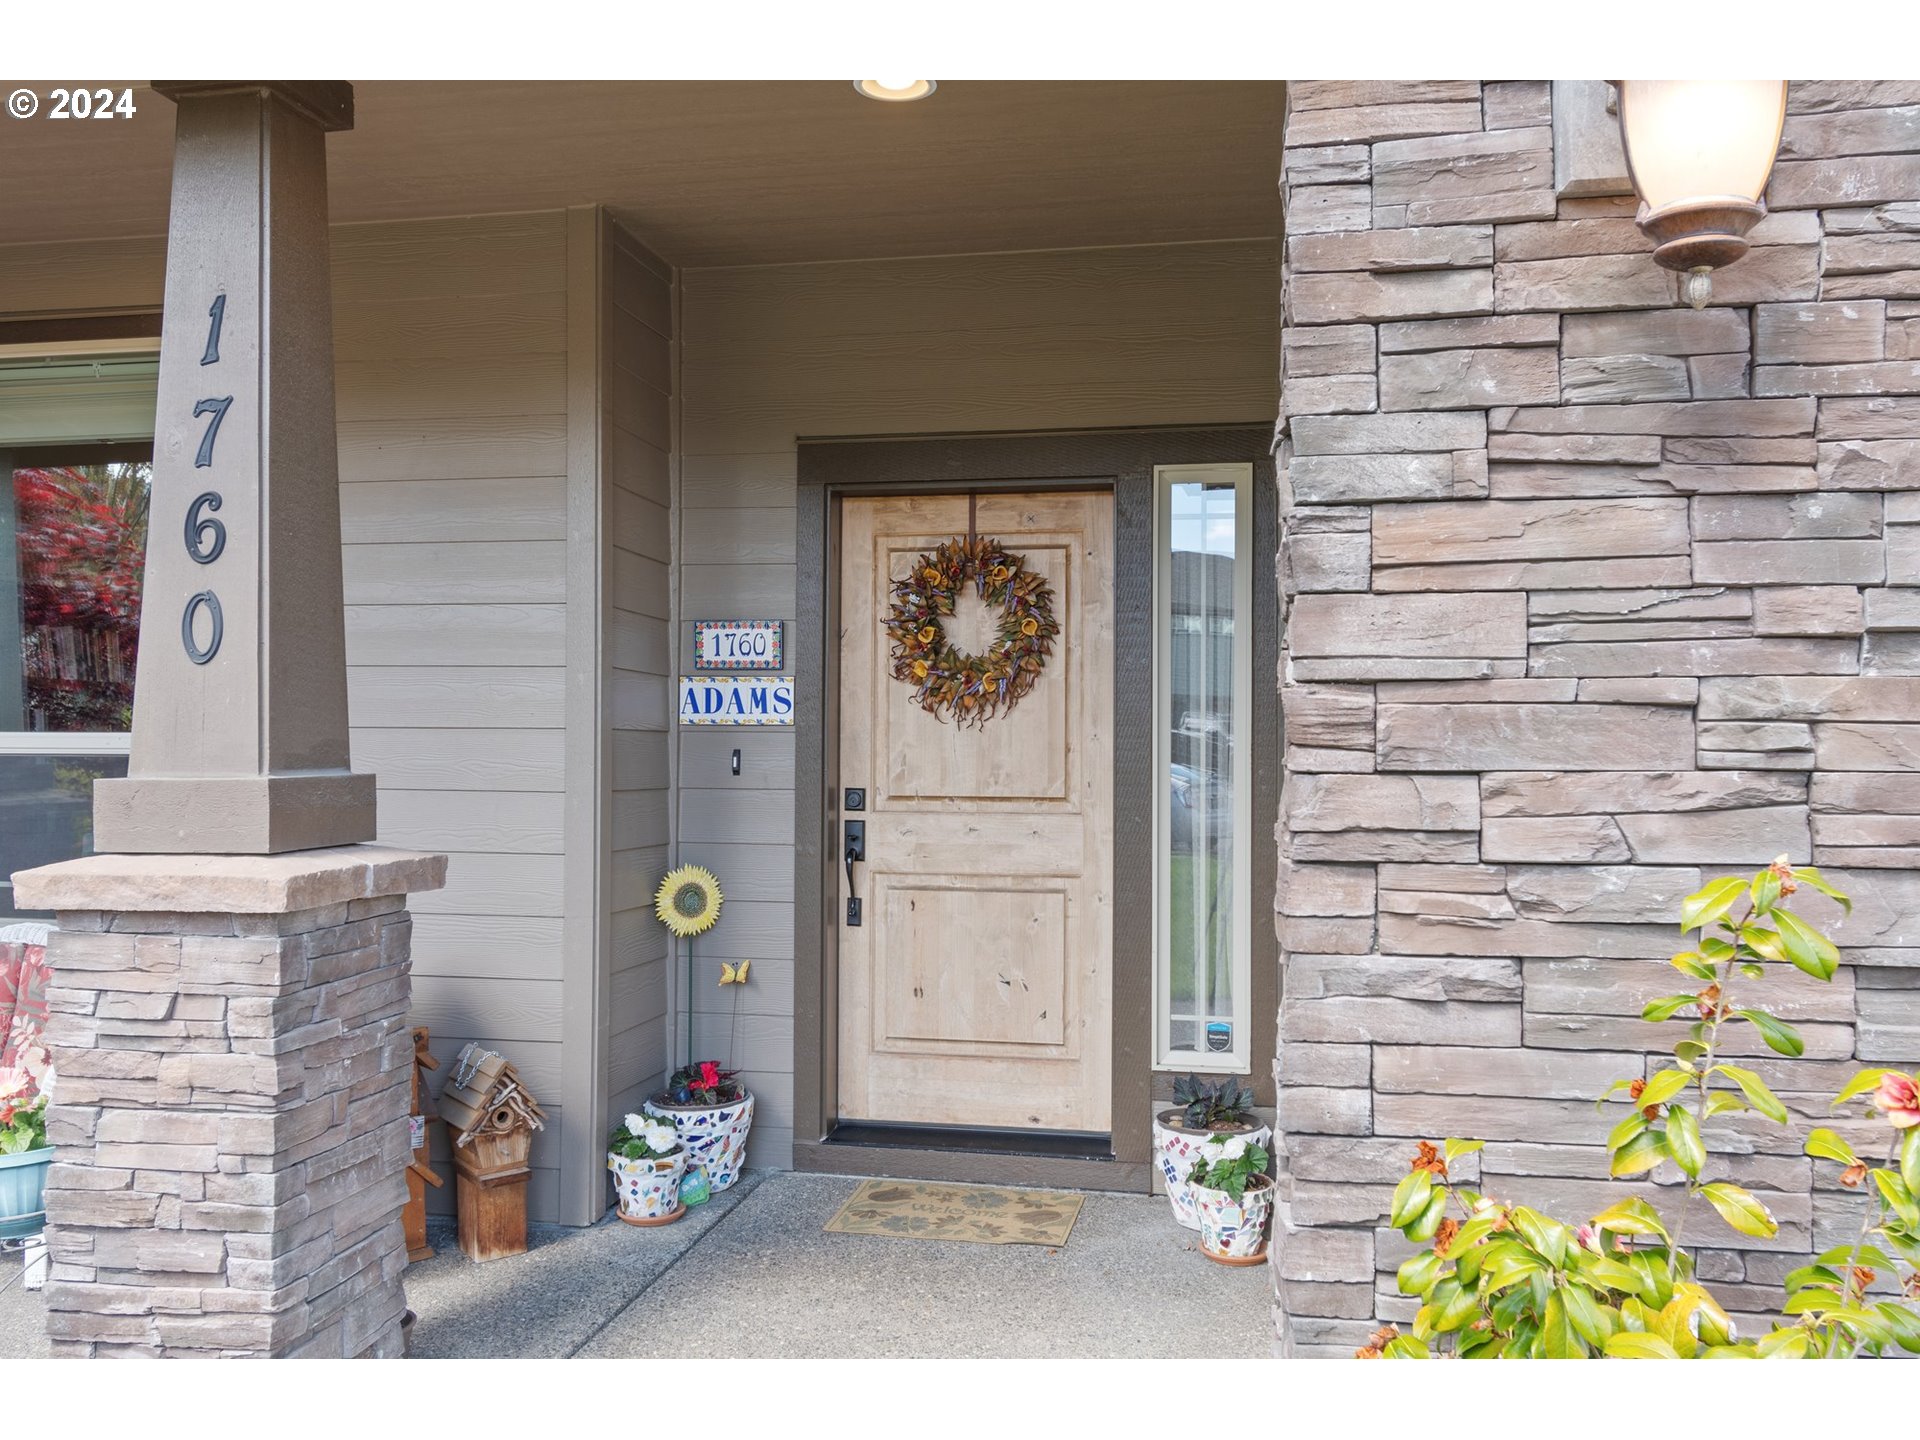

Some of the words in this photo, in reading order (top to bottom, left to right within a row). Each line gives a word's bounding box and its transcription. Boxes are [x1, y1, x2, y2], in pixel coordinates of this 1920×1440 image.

[181, 293, 234, 665] 1760
[711, 632, 767, 657] 1760
[681, 687, 792, 715] ADAMS
